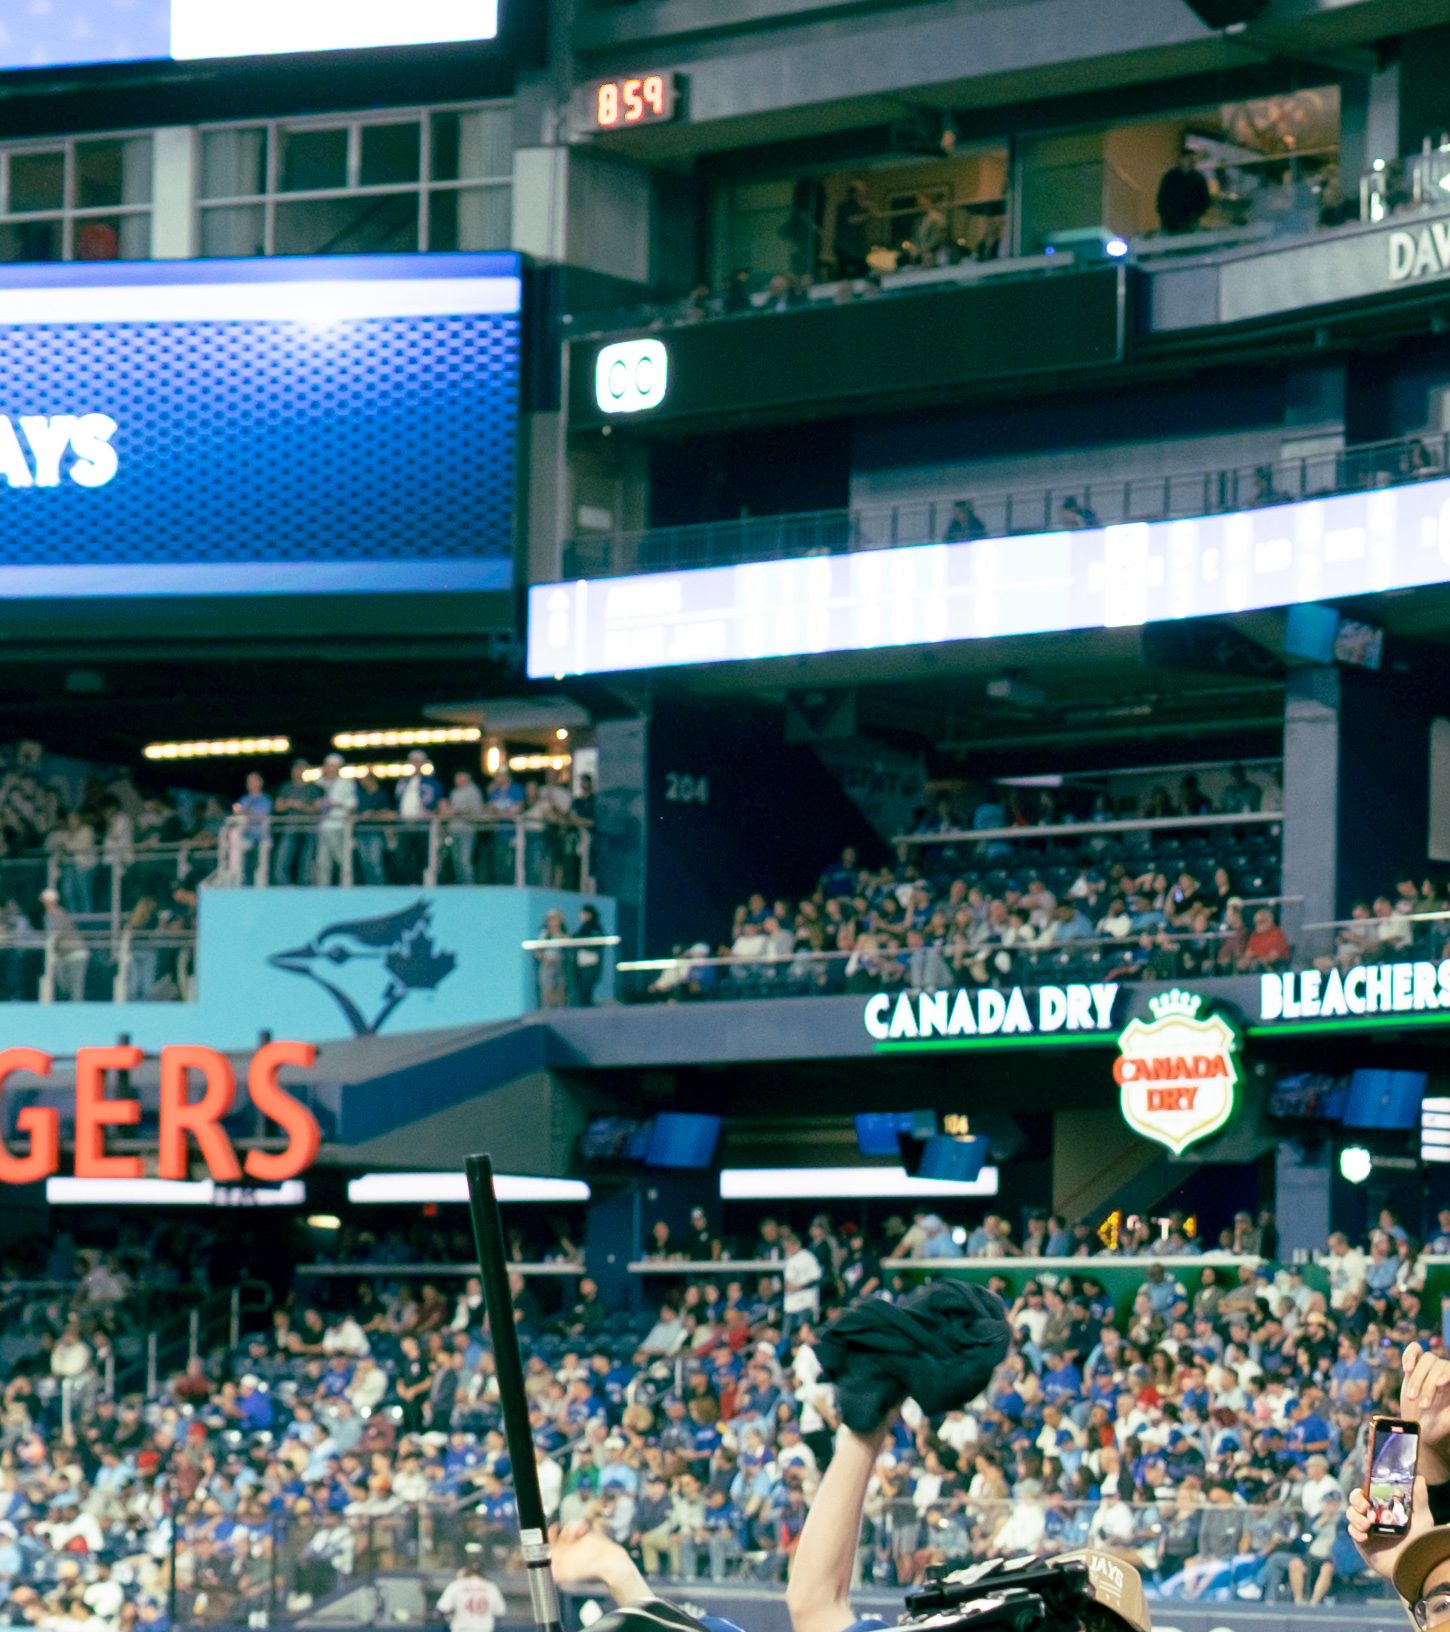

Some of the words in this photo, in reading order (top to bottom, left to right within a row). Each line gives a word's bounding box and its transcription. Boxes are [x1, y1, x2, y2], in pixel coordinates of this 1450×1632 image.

[664, 772, 710, 804] 204
[863, 986, 1034, 1041] CANADA
[1038, 982, 1121, 1033] DRY
[1112, 1053, 1229, 1086] CANADA
[0, 1040, 322, 1184] GERS
[1146, 1087, 1198, 1113] DRY
[1089, 1555, 1125, 1589] JAYS
